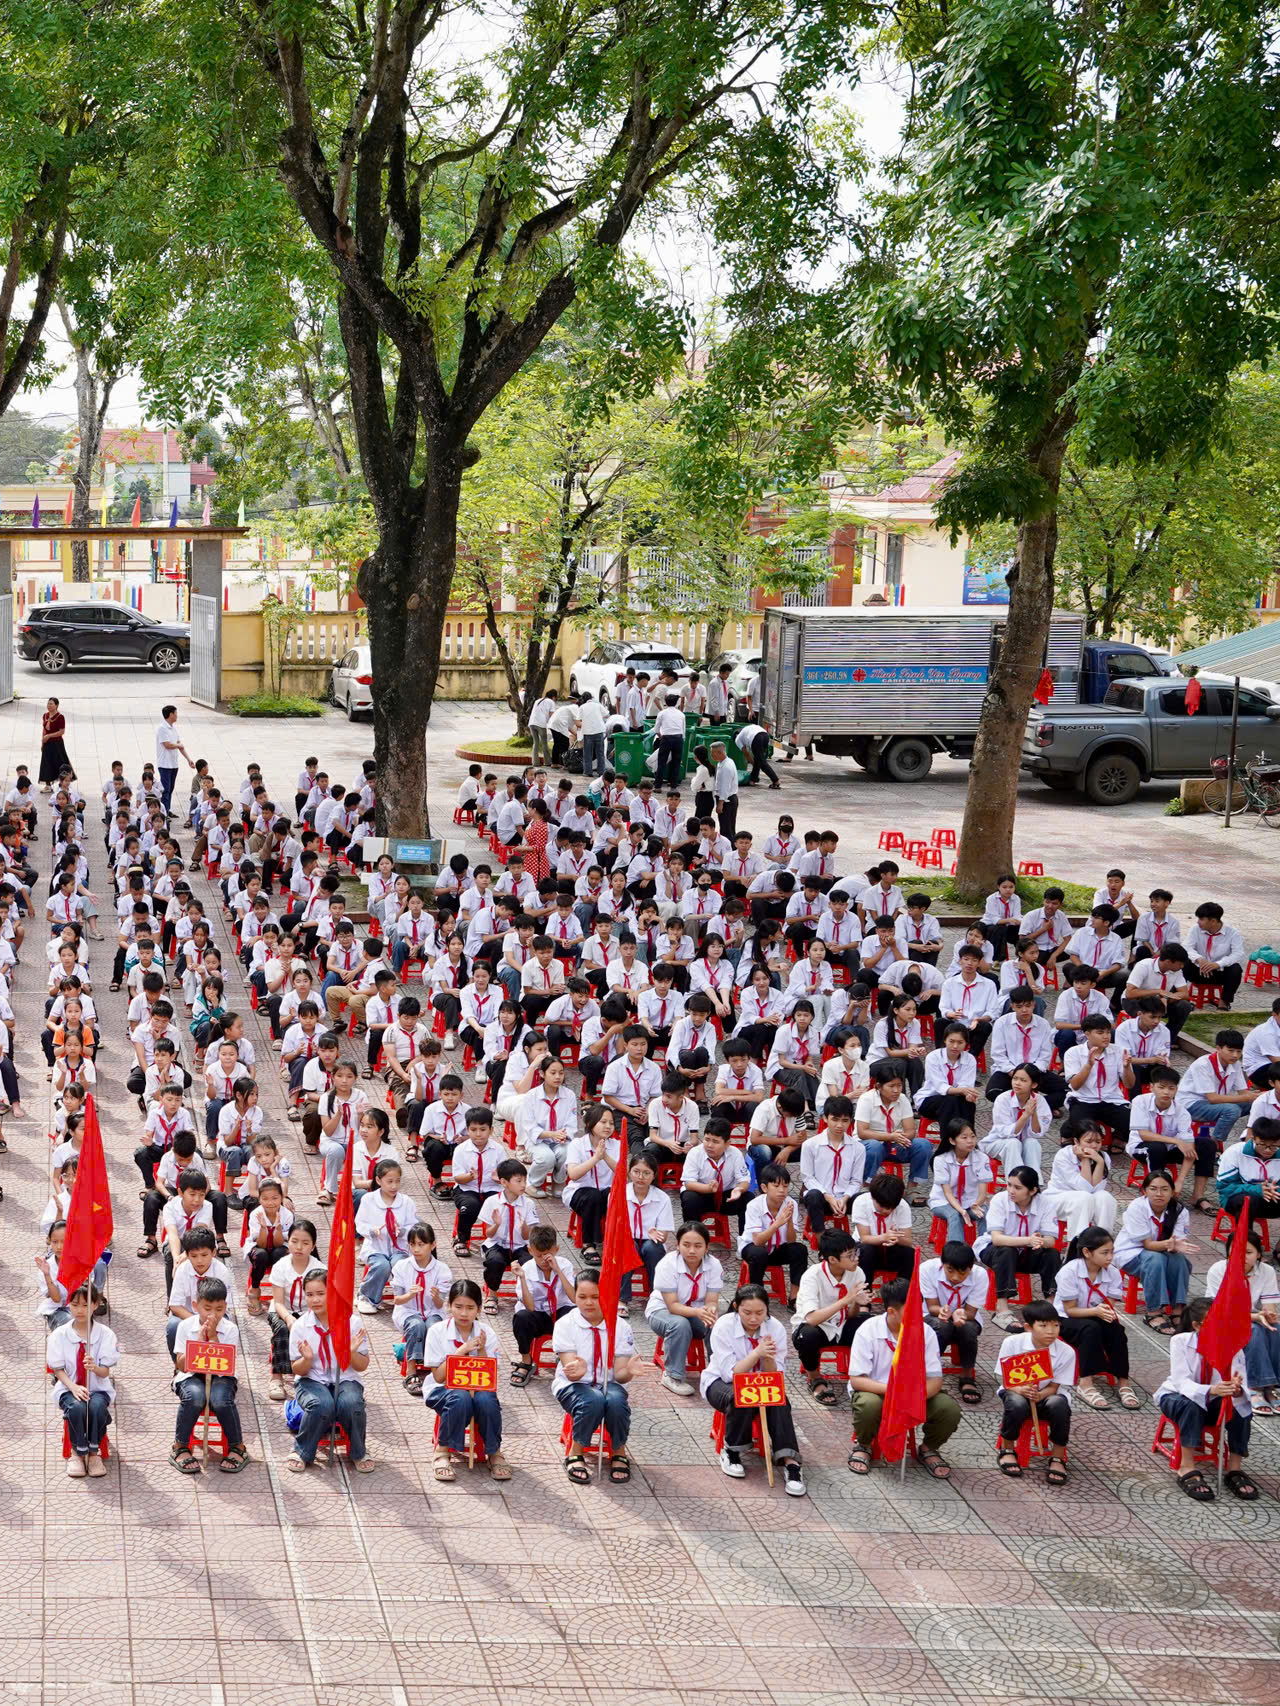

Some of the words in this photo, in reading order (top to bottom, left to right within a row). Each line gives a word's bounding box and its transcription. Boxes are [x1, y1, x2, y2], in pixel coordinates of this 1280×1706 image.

[191, 1355, 229, 1371] 4B
[452, 1369, 491, 1387] 5B
[1009, 1363, 1049, 1384] 8A
[740, 1385, 781, 1404] 8B
